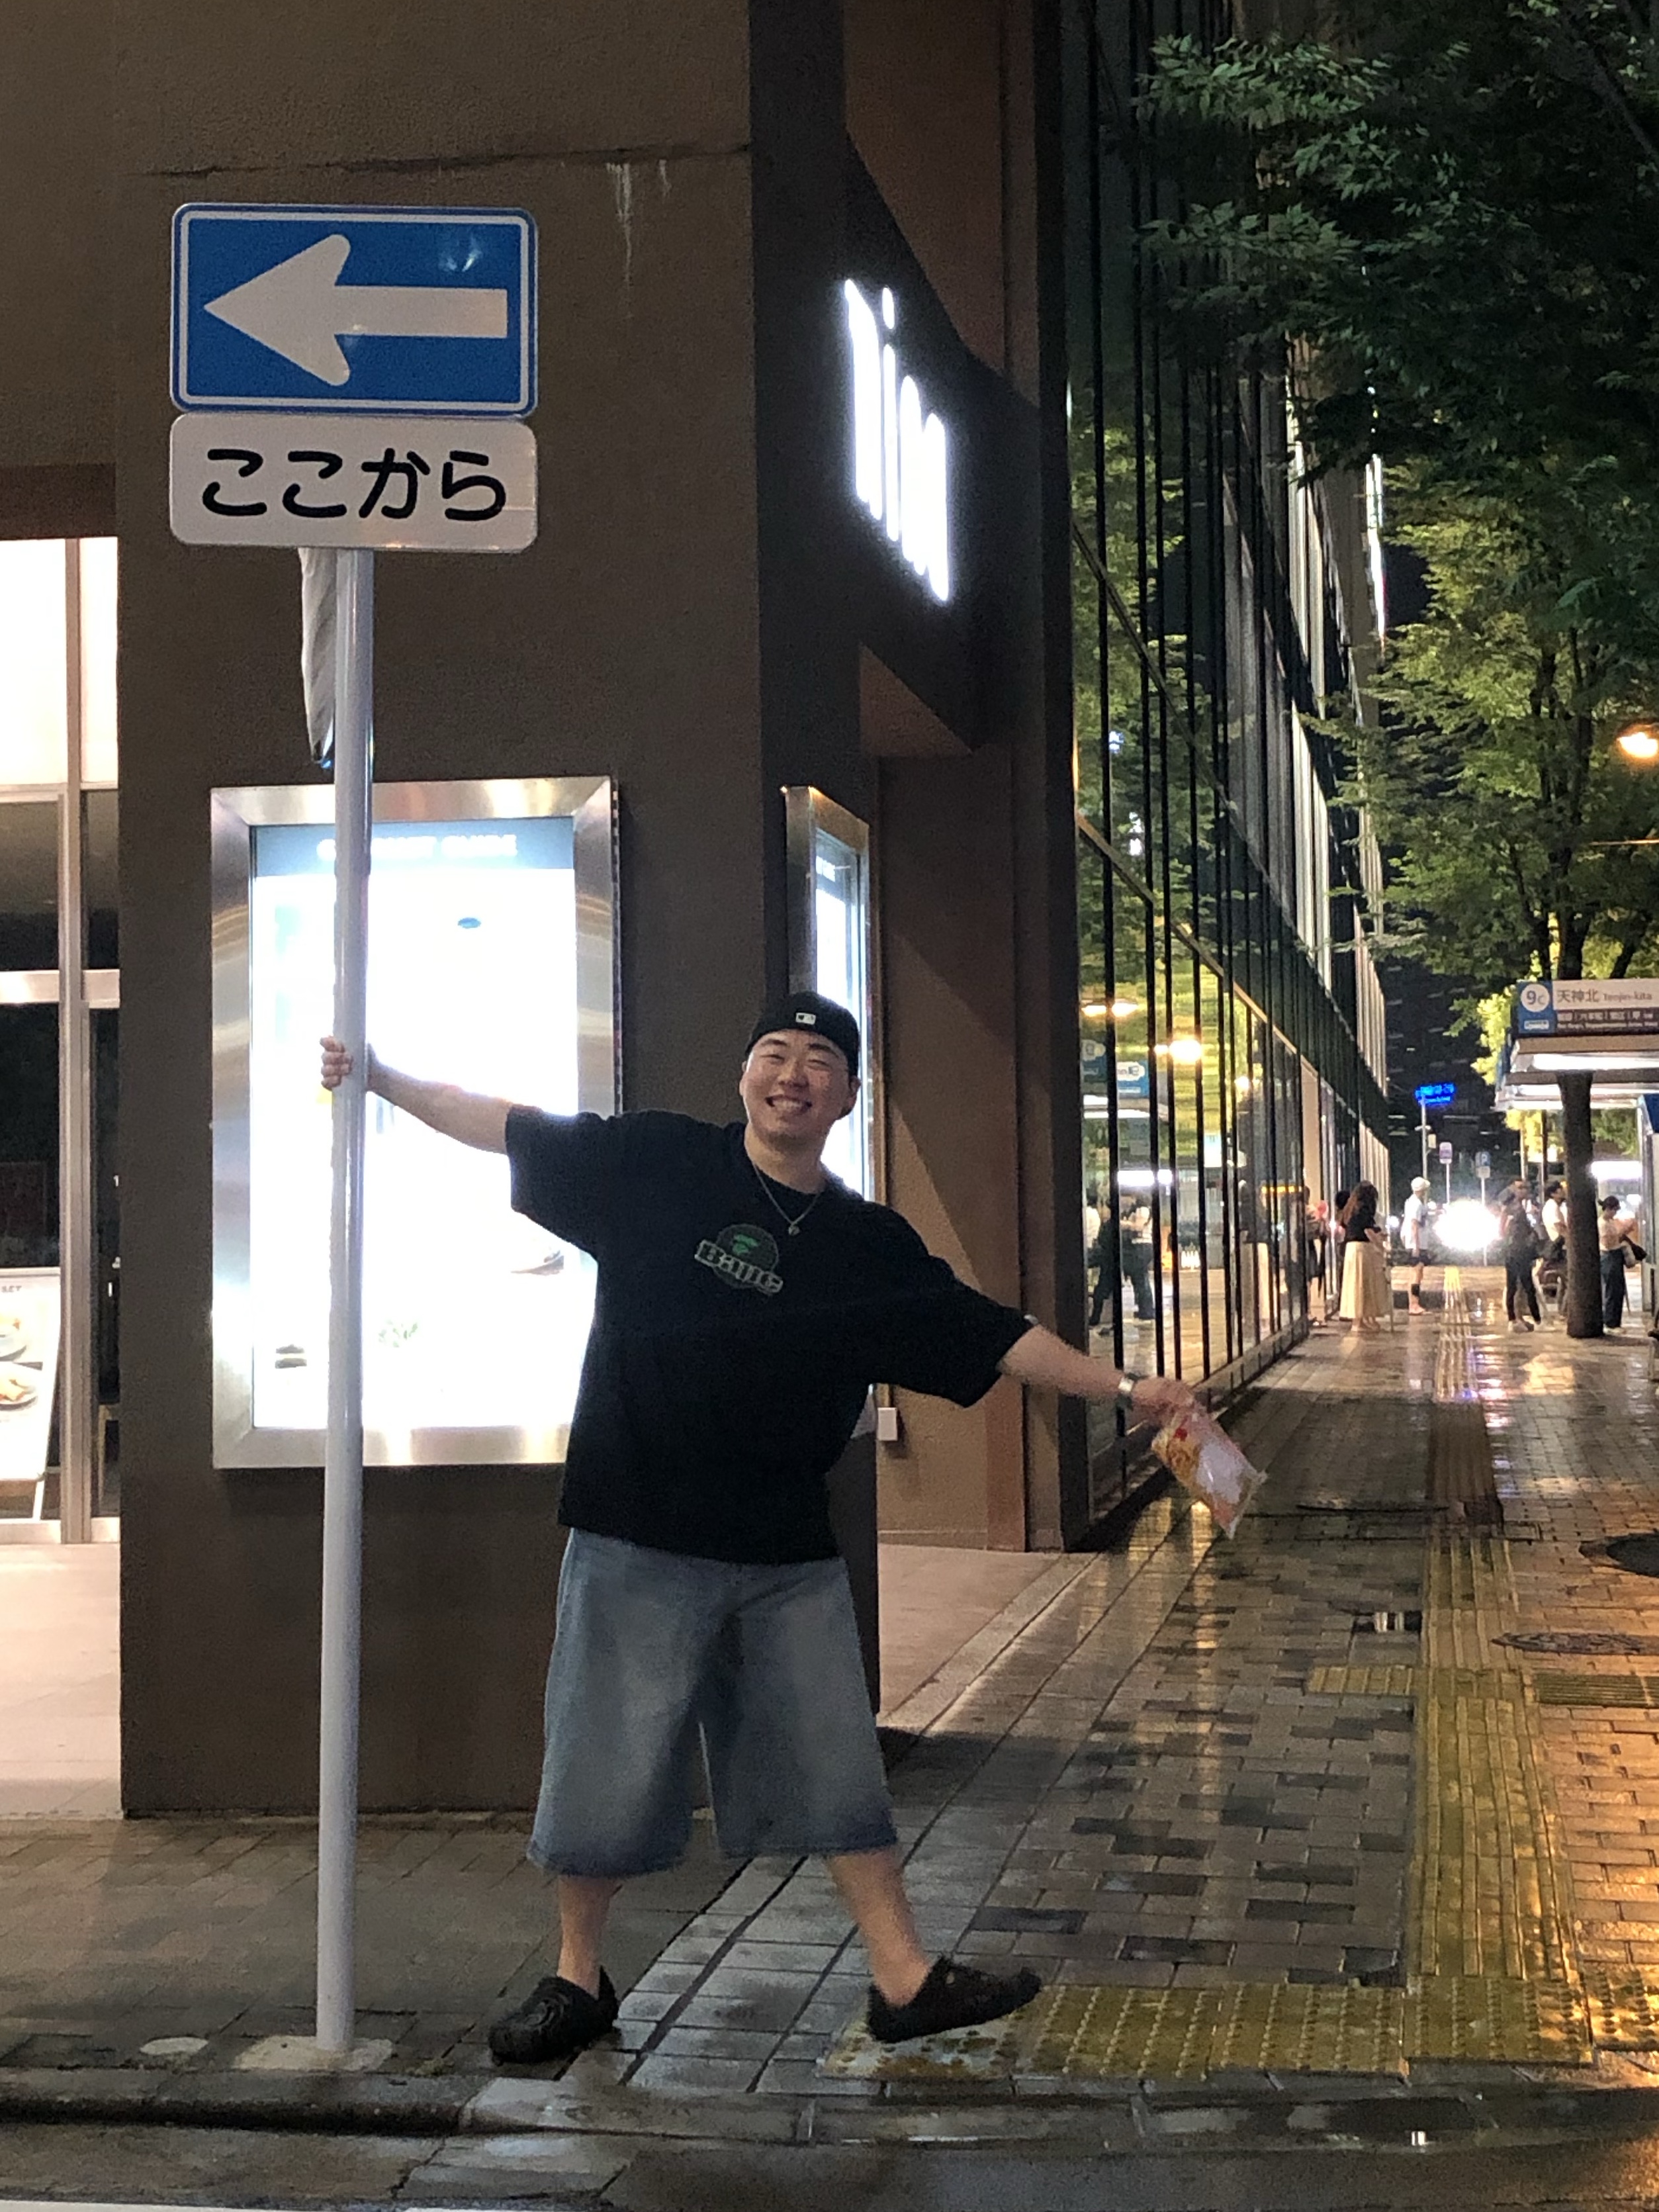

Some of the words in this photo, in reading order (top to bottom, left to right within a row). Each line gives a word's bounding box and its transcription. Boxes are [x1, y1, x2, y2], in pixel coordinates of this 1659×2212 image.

[202, 448, 506, 521] ここから
[1557, 988, 1599, 1003] 天神北
